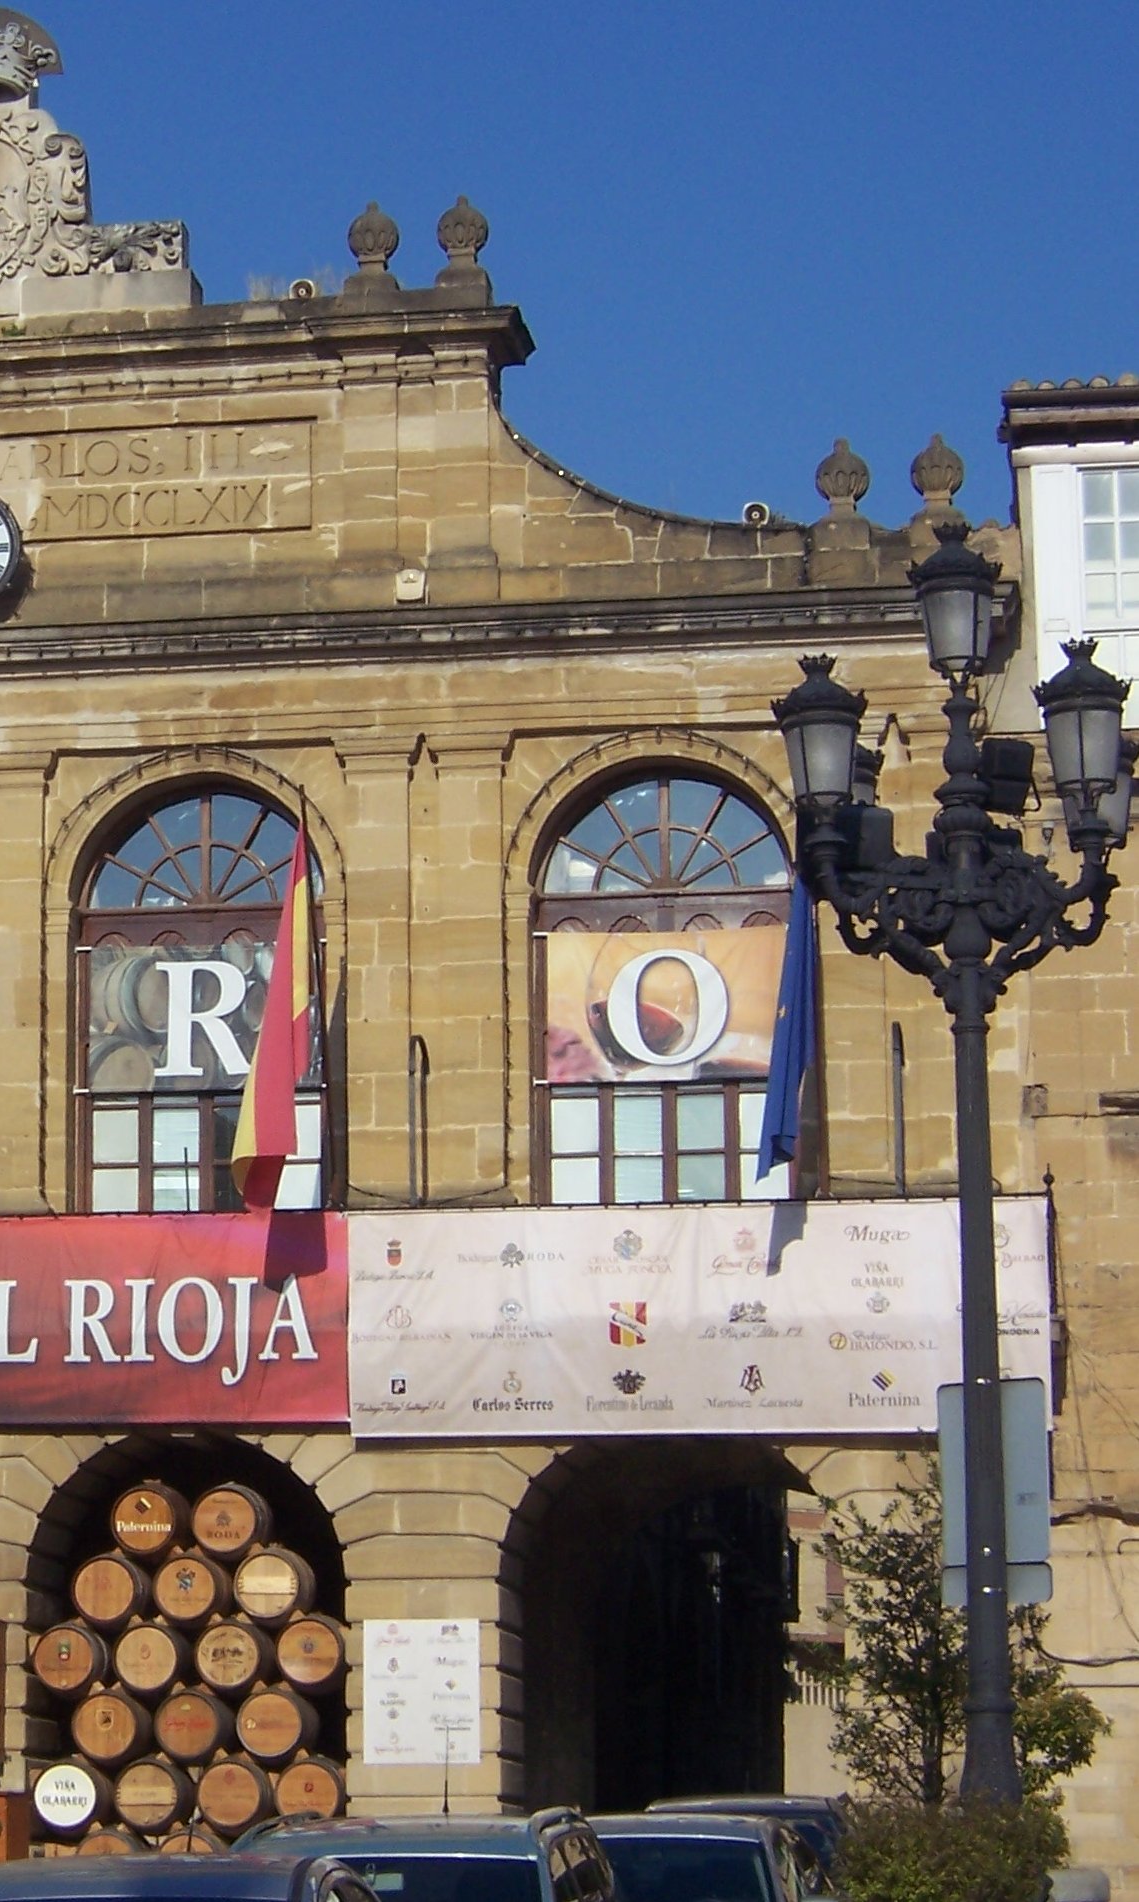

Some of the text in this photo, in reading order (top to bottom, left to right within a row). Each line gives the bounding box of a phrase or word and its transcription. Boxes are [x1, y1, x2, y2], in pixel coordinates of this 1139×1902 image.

[184, 432, 246, 471] III
[607, 947, 730, 1067] O
[155, 960, 253, 1078] R
[843, 1225, 911, 1244] Muga
[527, 1252, 566, 1261] RODA
[864, 1259, 889, 1274] VIÑA
[63, 1273, 319, 1387] RIOJA
[473, 1397, 554, 1412] Carlos Serres
[848, 1392, 921, 1408] Paternina
[116, 1520, 172, 1533] Paternina
[54, 1779, 76, 1791] VIÑA
